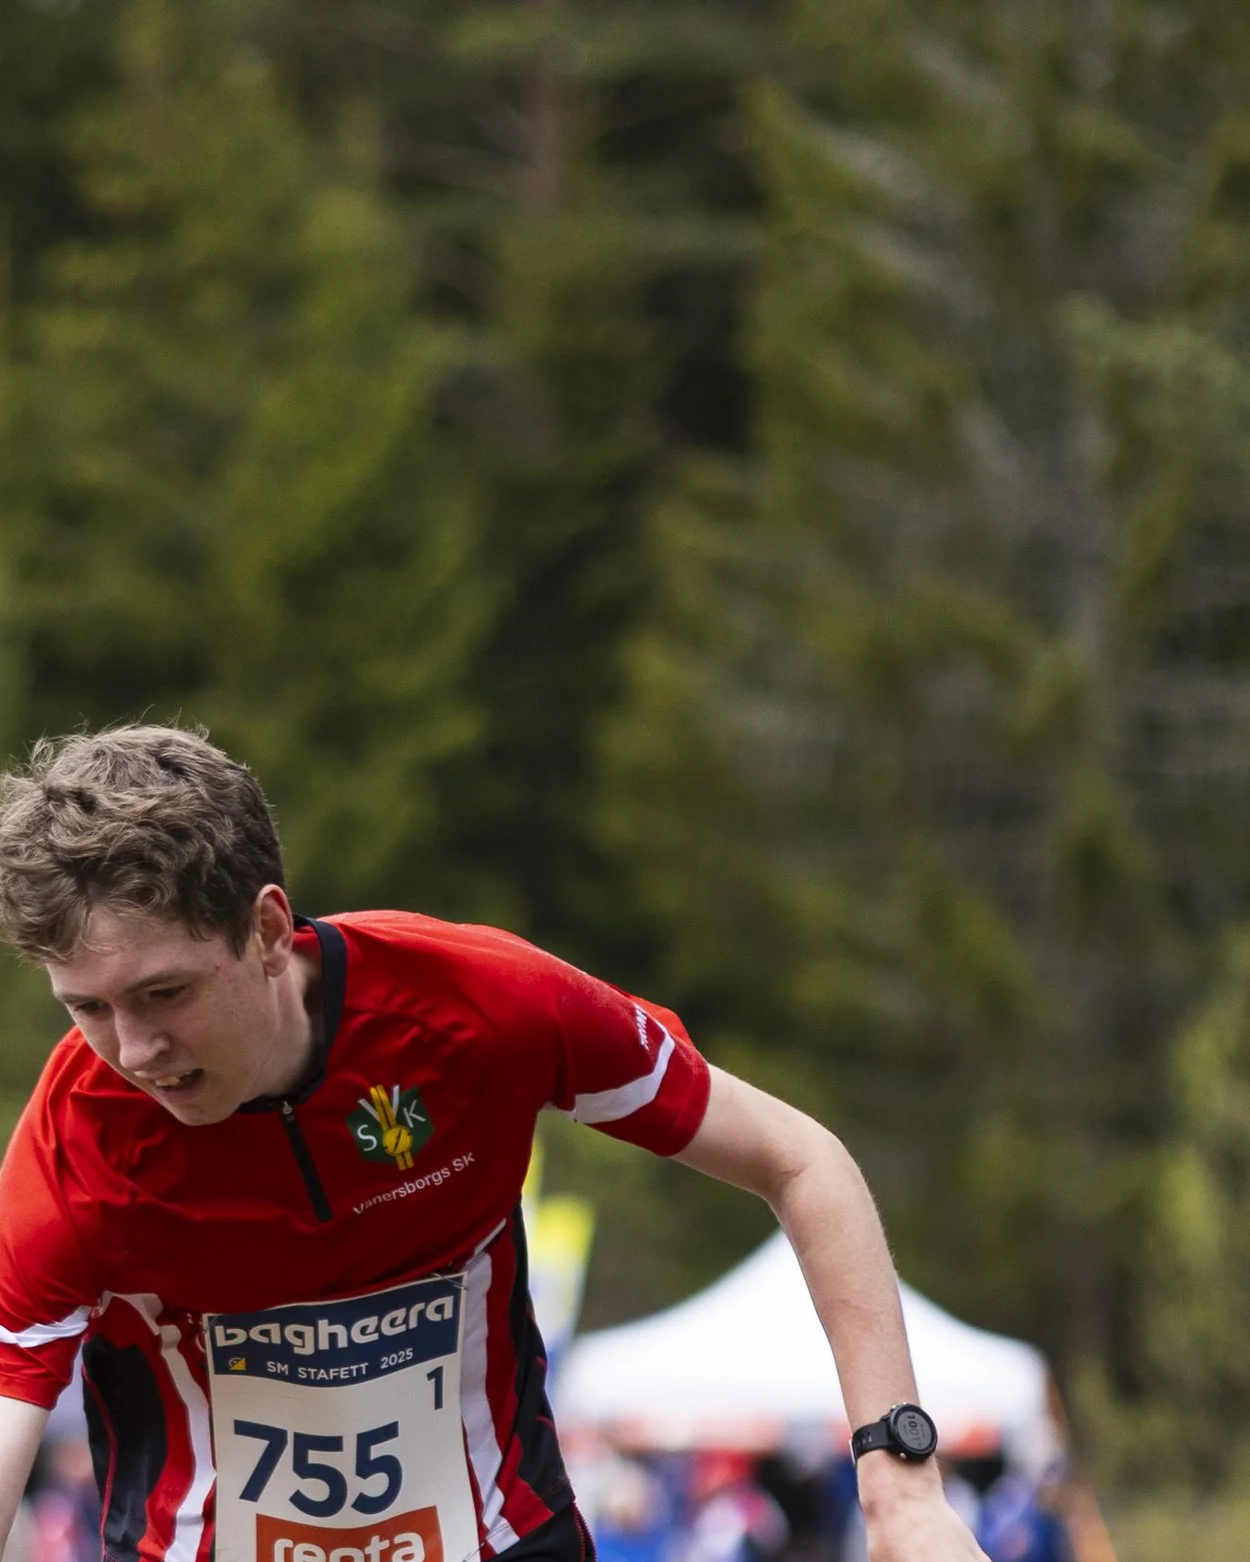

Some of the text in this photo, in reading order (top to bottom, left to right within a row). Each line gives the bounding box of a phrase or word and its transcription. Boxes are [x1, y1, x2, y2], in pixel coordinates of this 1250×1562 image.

[452, 1152, 476, 1173] SK
[214, 1294, 454, 1355] bagheera
[266, 1348, 414, 1380] SM STAFETT 2025
[426, 1366, 444, 1410] 1
[234, 1419, 403, 1518] 755
